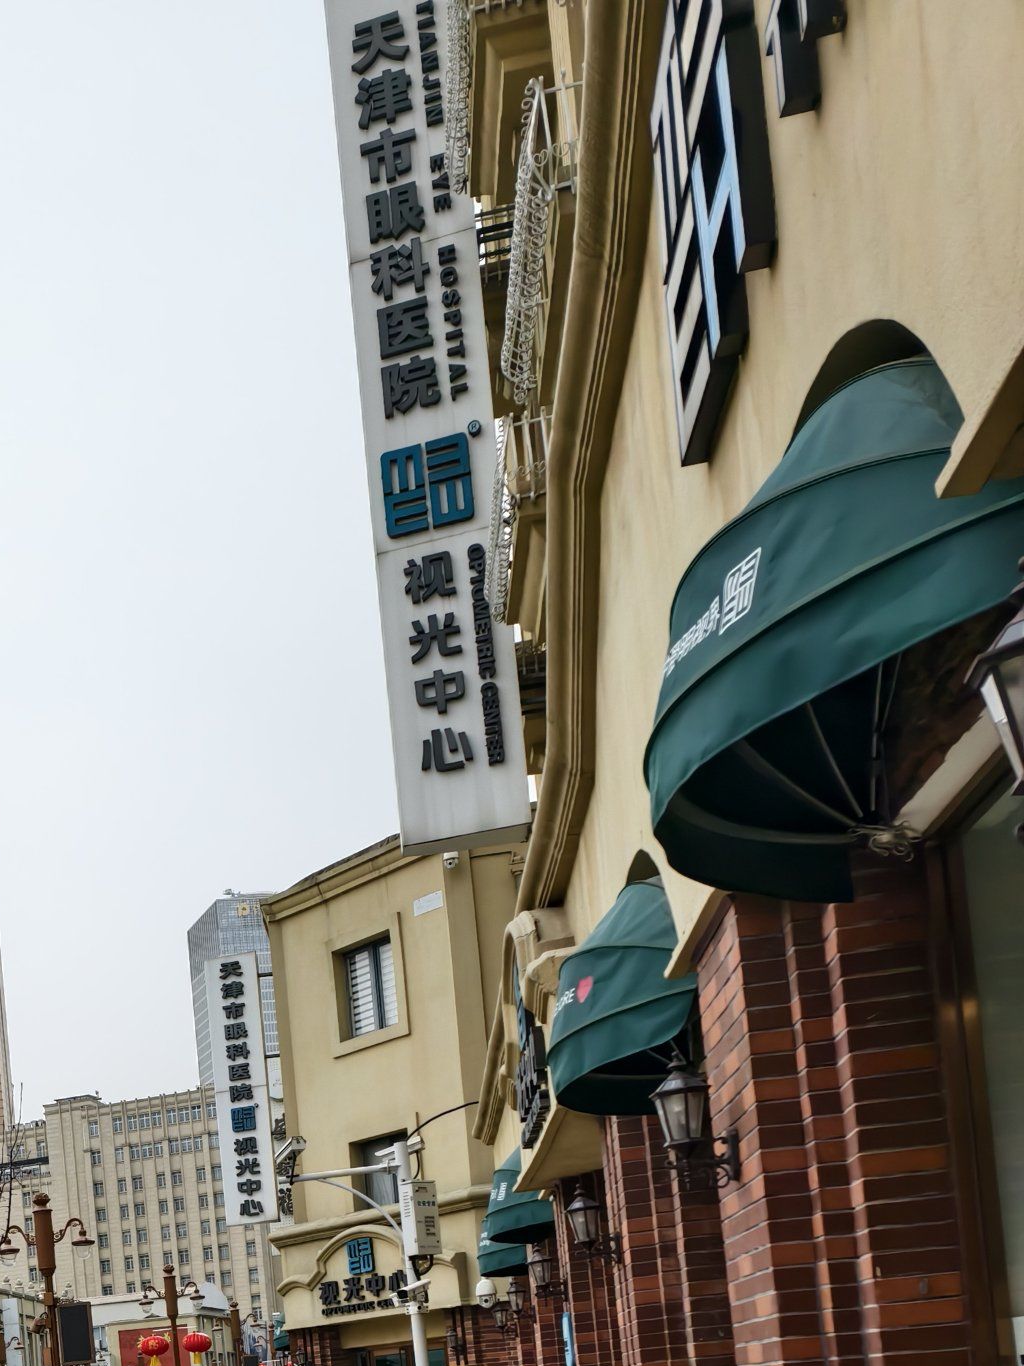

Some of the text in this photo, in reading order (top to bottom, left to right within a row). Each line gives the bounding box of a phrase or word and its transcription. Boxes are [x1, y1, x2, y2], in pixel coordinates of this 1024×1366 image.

[351, 10, 442, 419] 天津市眼科医院
[416, 0, 469, 401] TIANJIN EYE HOSPITAL
[403, 550, 474, 773] 视光中心
[467, 542, 506, 766] OPTOMETRIC CENTER
[219, 960, 253, 1103] 天津市眼科医院
[234, 1136, 264, 1217] 视光中心
[318, 1269, 408, 1307] 视光中心
